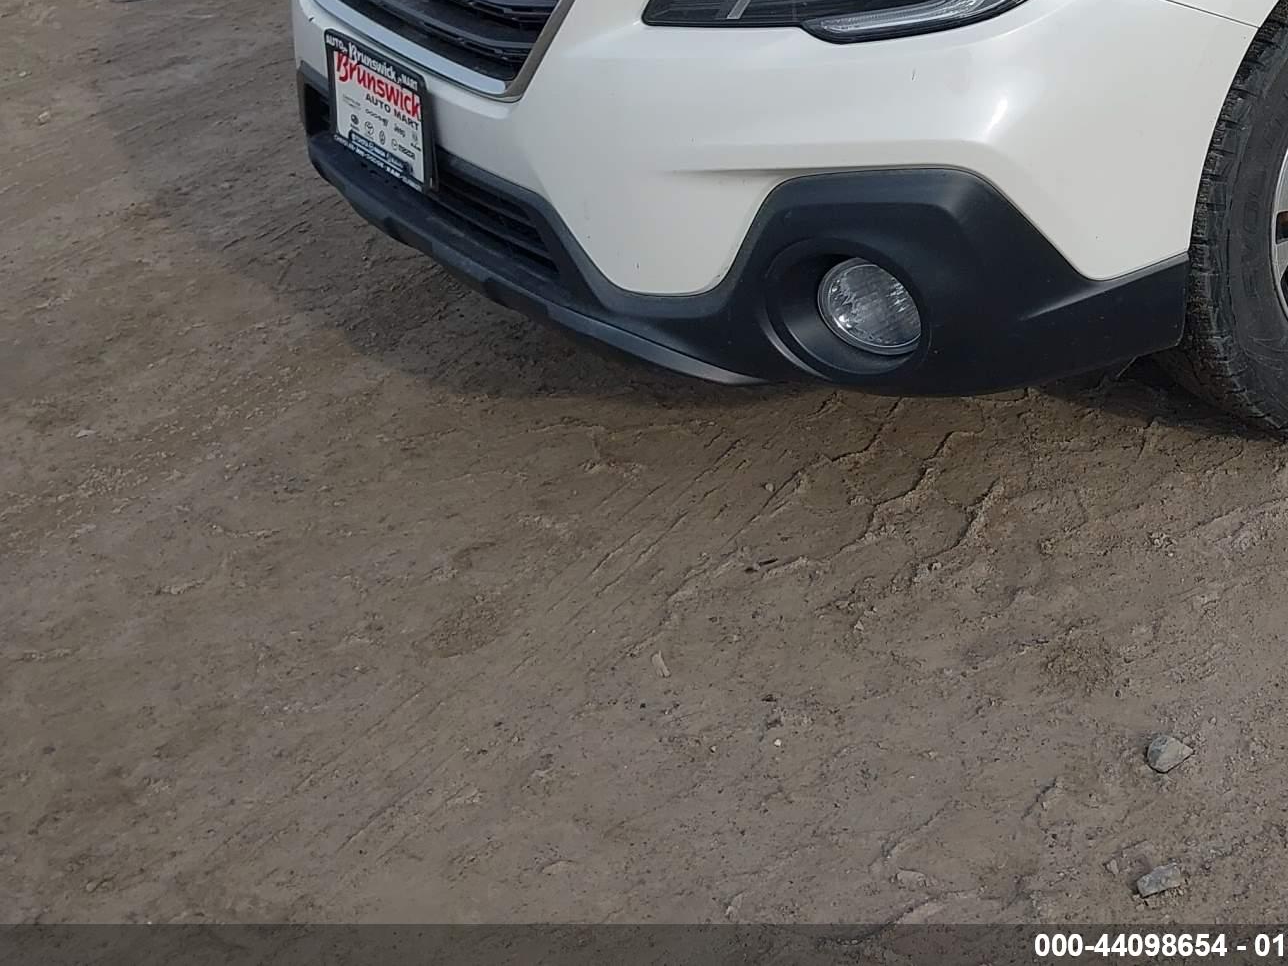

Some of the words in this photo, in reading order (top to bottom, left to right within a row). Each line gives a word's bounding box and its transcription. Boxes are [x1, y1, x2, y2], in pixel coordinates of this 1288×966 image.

[348, 42, 397, 83] Brunswick
[336, 52, 421, 121] Brunswick
[365, 93, 391, 113] AUTO
[393, 109, 419, 131] MART
